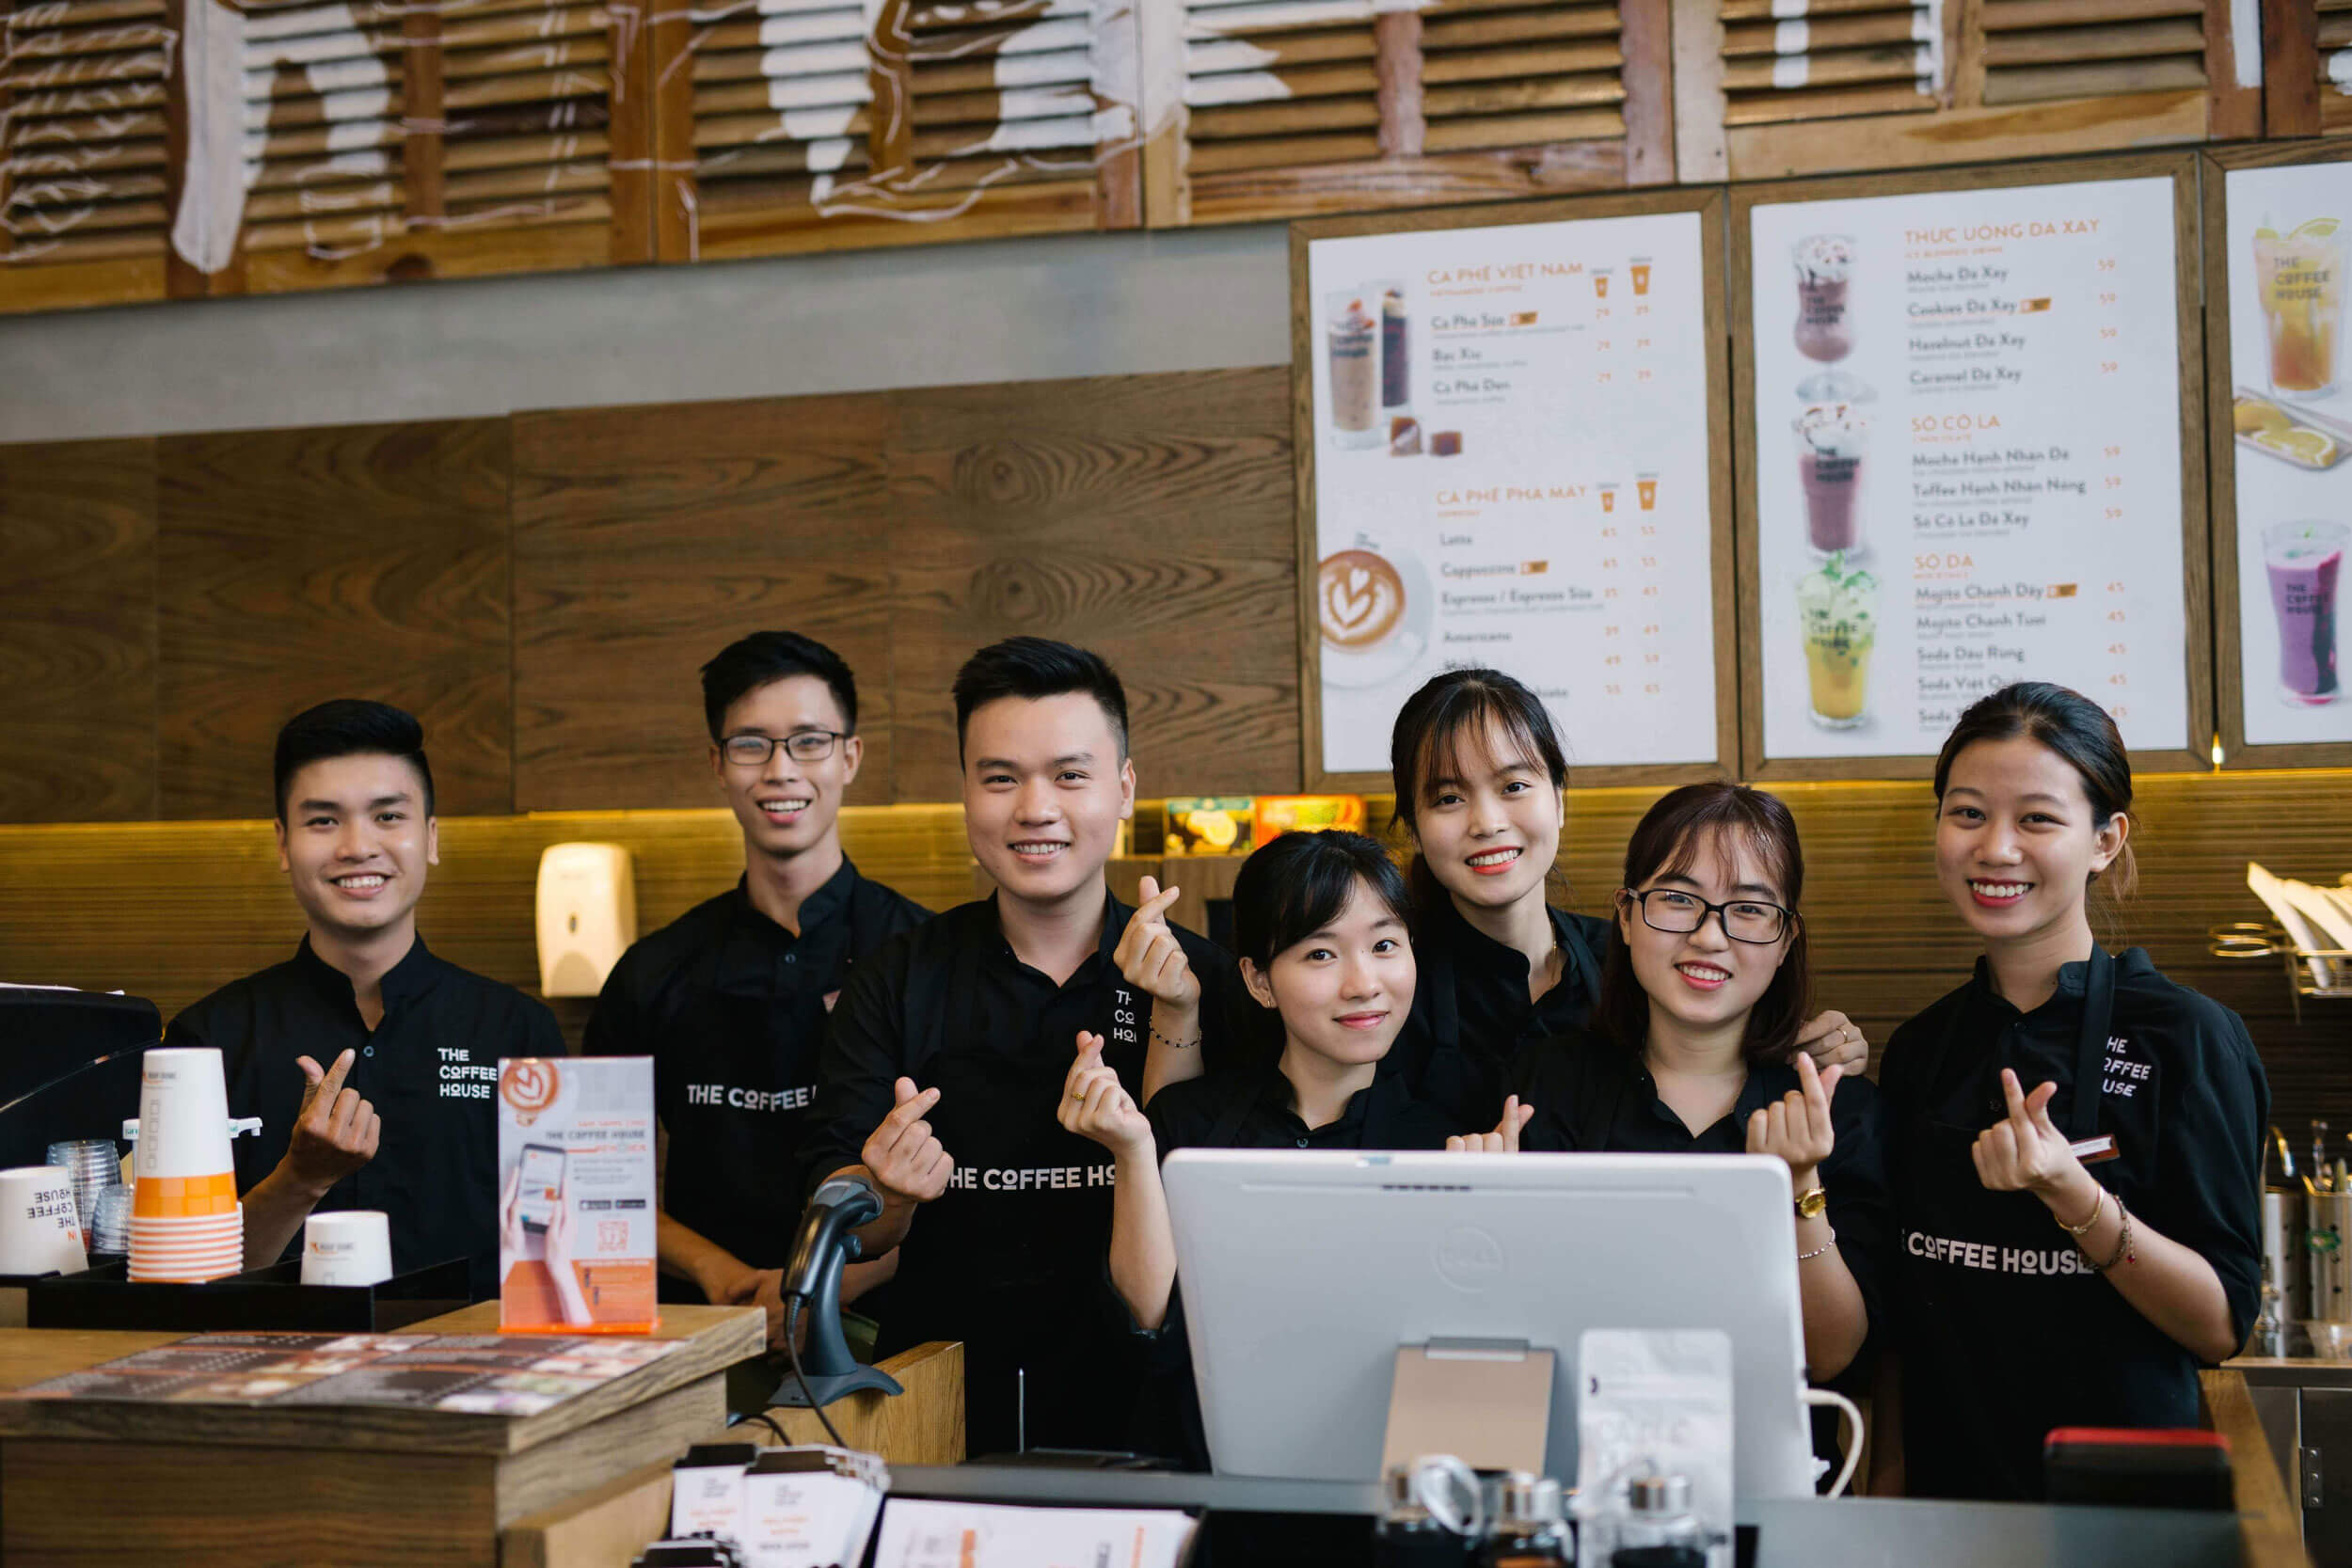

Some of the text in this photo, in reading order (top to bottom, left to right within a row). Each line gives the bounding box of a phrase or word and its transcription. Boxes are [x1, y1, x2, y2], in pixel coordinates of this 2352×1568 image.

[1541, 262, 1583, 276] NAM
[2275, 257, 2300, 269] THE
[2275, 270, 2330, 286] COFFEE
[2275, 287, 2322, 300] HOUSE
[2106, 1036, 2128, 1054] HE
[438, 1048, 469, 1062] THE
[439, 1065, 498, 1082] COFFEE
[439, 1083, 490, 1099] HOUSE
[2102, 1079, 2137, 1098] USE
[687, 1085, 809, 1113] THE COFFEE
[949, 1167, 977, 1189] HE
[983, 1167, 1081, 1191] COFFEE
[34, 1189, 71, 1203] HOUSE
[26, 1202, 73, 1219] COFFEE
[57, 1216, 75, 1228] THE
[1908, 1230, 1997, 1270] COFFEE
